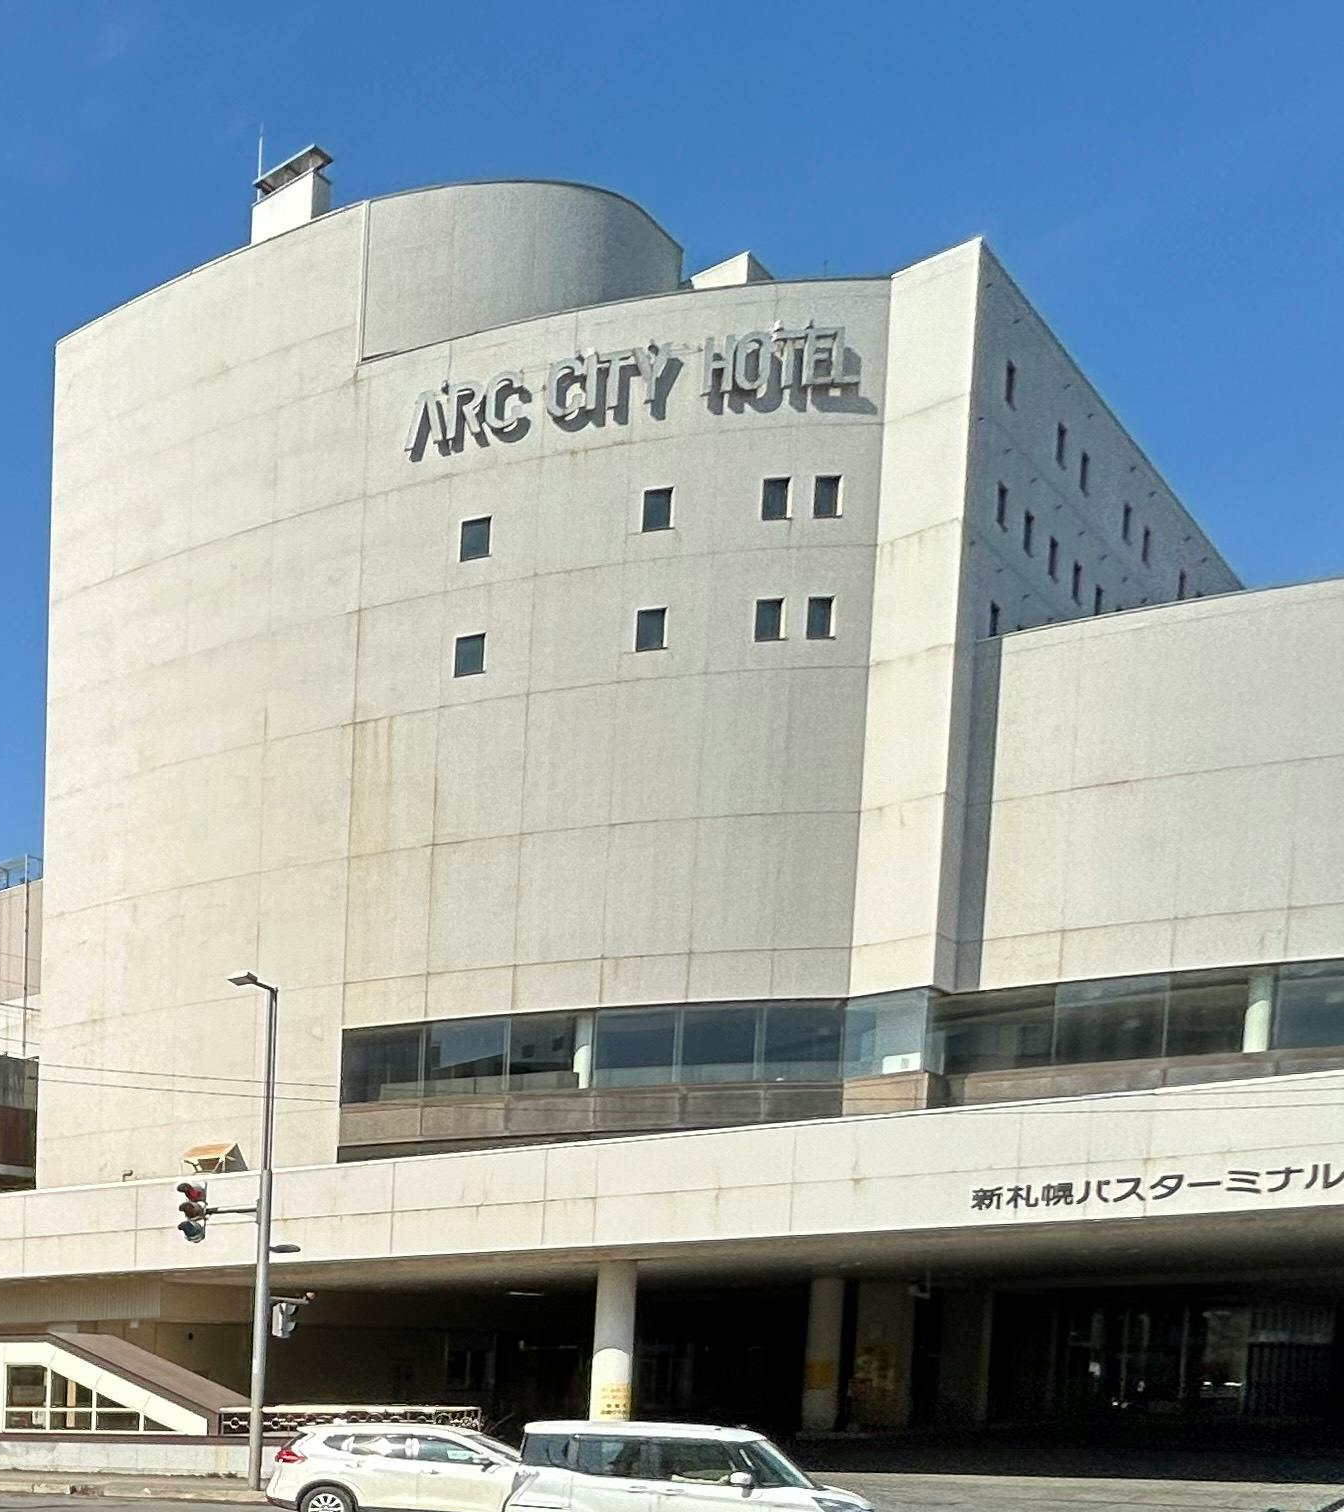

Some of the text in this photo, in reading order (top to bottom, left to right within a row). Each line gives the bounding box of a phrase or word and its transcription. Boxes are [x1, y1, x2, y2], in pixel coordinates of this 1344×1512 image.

[404, 325, 861, 453] ARC CITY HOTEL
[971, 1163, 1344, 1211] 新札幌バスターミナル
